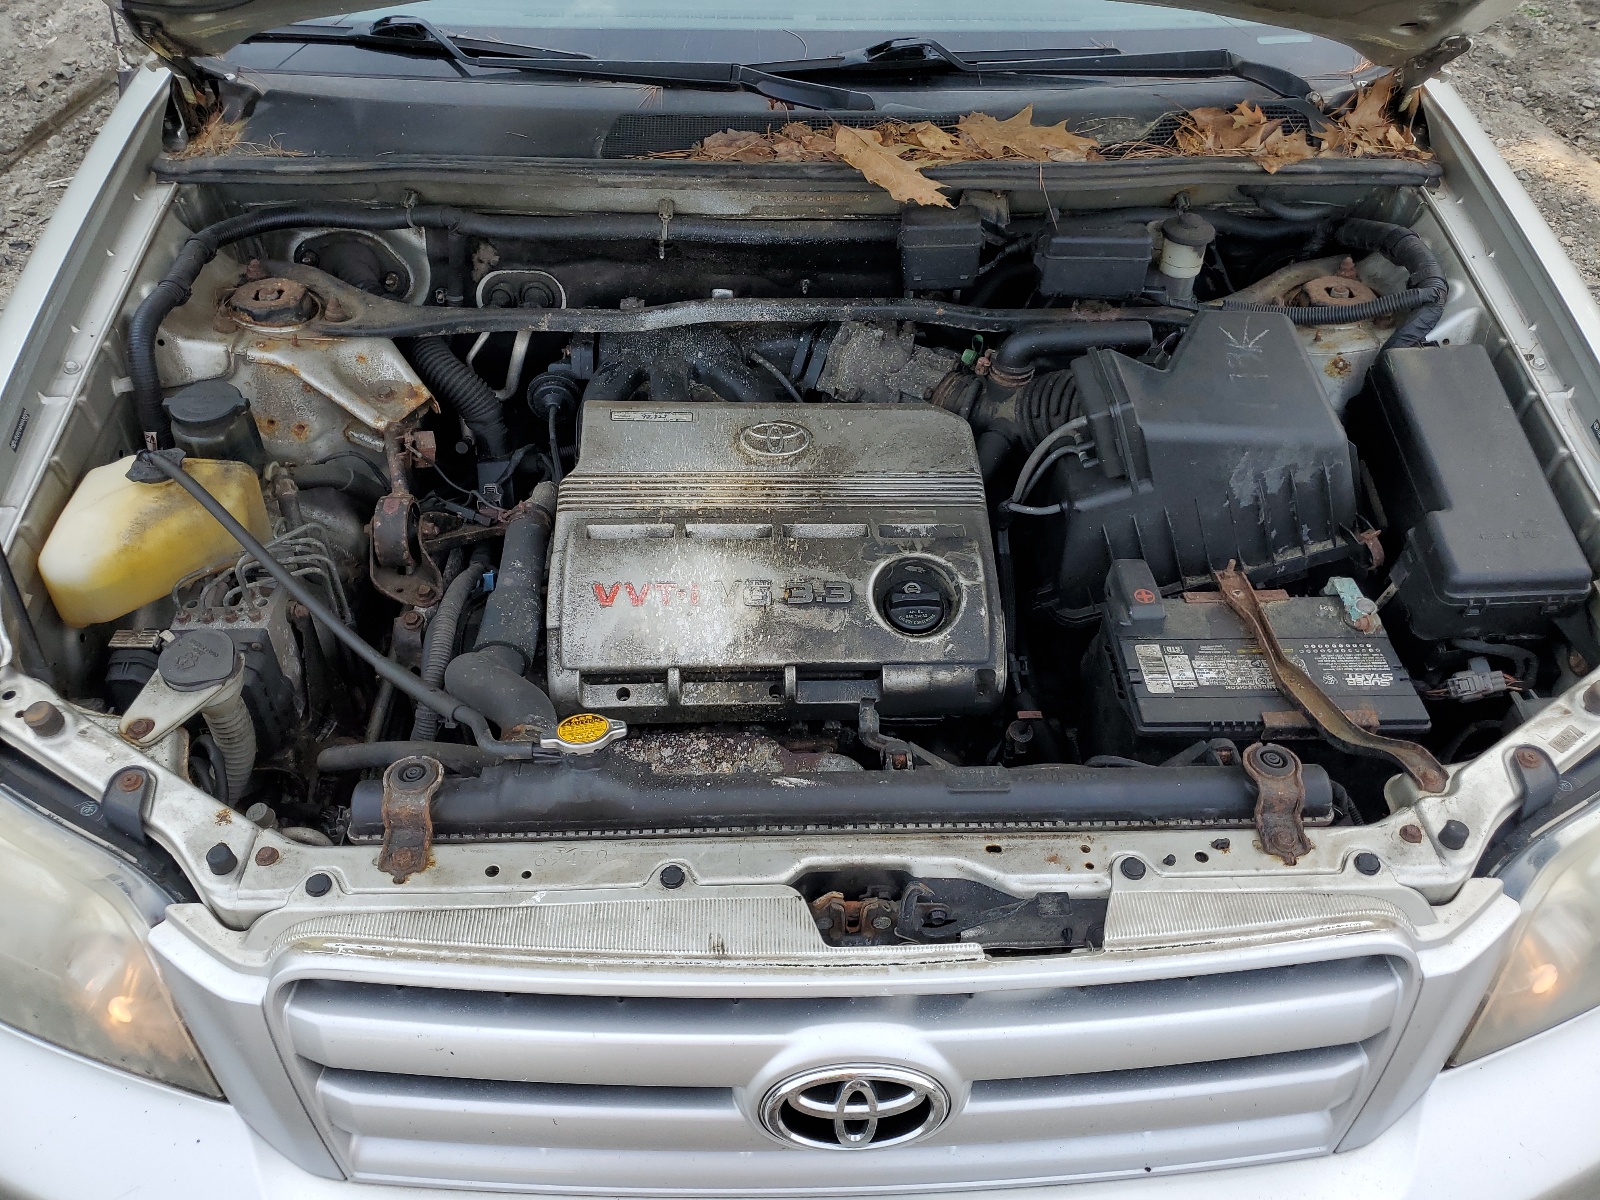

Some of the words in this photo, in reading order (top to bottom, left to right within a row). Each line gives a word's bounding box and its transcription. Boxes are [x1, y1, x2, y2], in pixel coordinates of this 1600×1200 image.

[786, 581, 852, 604] 3.3
[1344, 672, 1394, 681] START
[1347, 679, 1391, 687] SUPER
